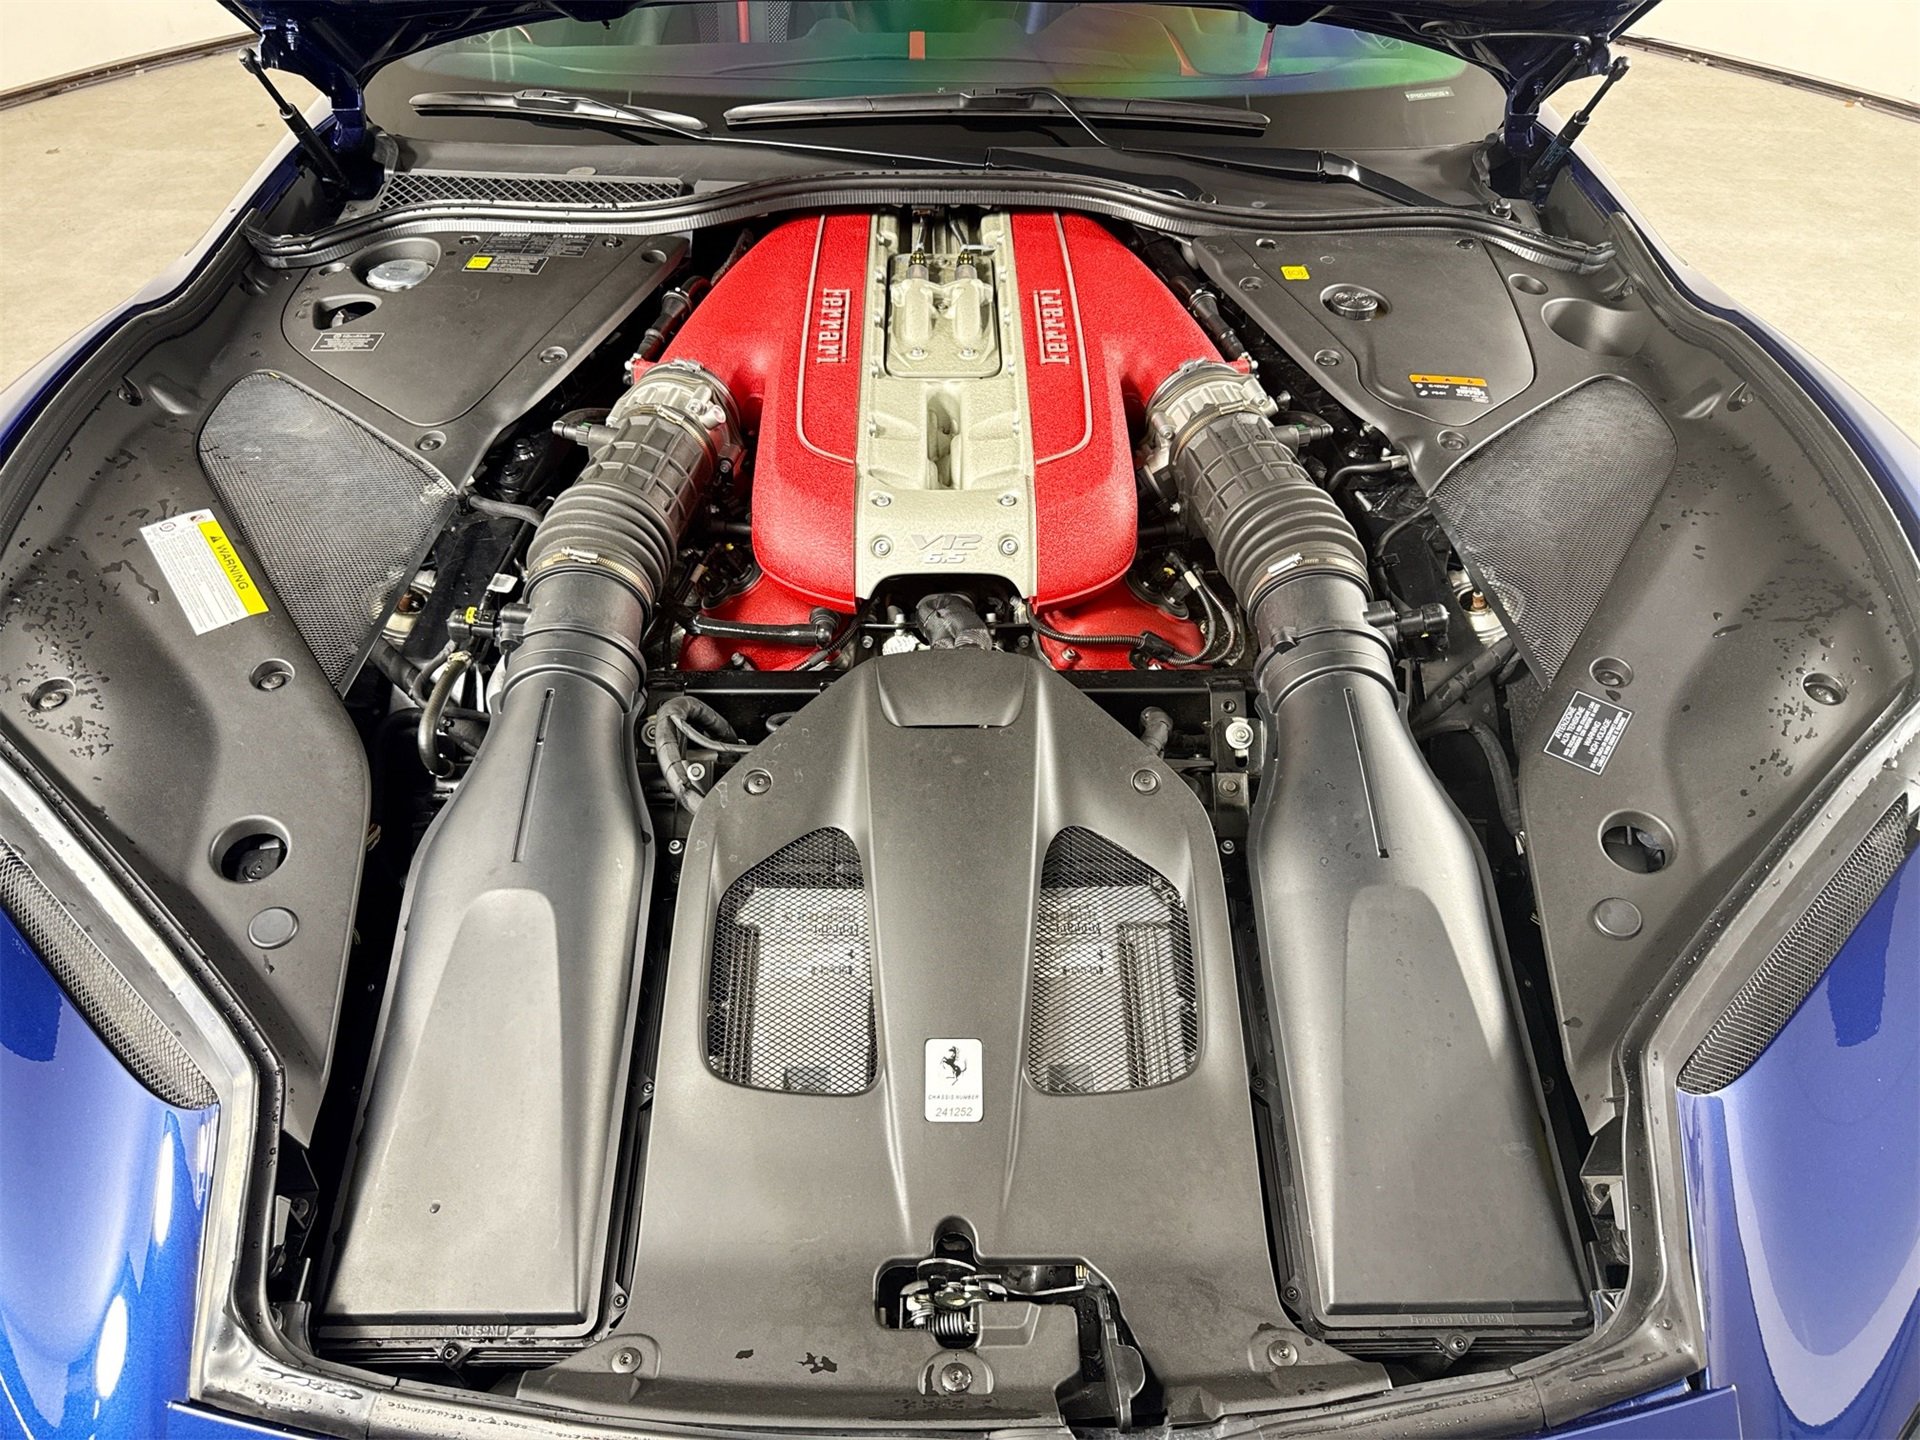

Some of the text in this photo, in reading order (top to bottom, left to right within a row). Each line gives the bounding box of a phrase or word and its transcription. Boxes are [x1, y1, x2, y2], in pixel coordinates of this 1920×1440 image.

[816, 288, 850, 364] Ferrari
[1033, 289, 1071, 365] Ferrari
[910, 534, 983, 551] V12
[922, 552, 968, 565] 6.5
[216, 544, 249, 591] WARNING
[1554, 706, 1577, 740] ATTENZIONE
[1560, 731, 1572, 746] ALTA
[1566, 706, 1586, 733] TENSIONE
[1583, 720, 1602, 747] WARNING
[1587, 740, 1600, 756] HIGH
[1594, 717, 1613, 742] VOLTAGE
[935, 1106, 973, 1117] 241252
